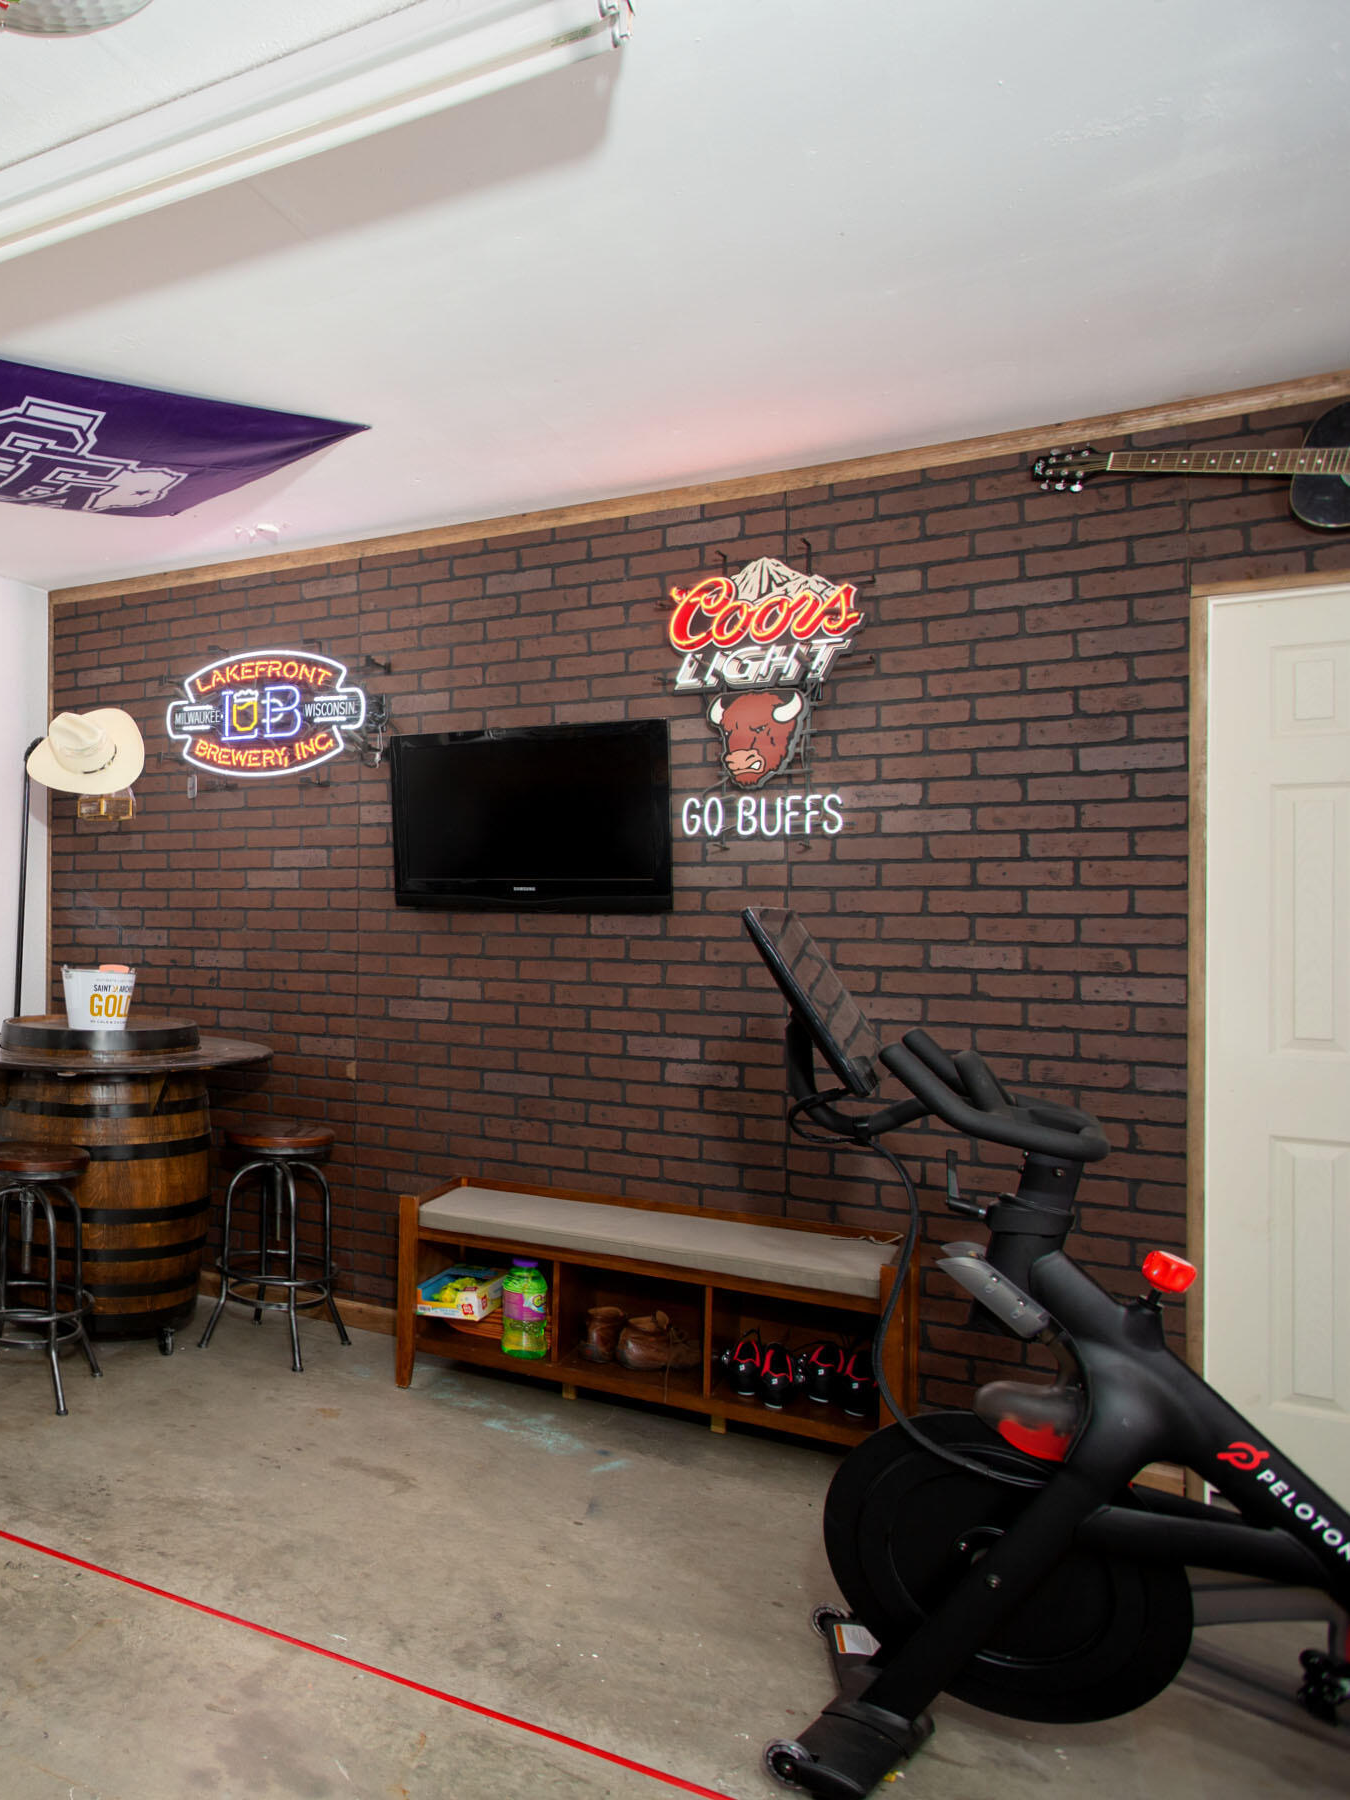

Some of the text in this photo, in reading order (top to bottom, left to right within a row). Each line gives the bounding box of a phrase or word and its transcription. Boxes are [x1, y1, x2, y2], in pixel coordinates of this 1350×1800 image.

[668, 576, 863, 652] Coors
[196, 659, 333, 694] LAKEFRONT
[674, 637, 852, 692] LIGHT
[174, 710, 222, 725] MILWAUKEE
[304, 700, 356, 718] WISCONSIN
[194, 738, 290, 768] BREWERY,
[681, 794, 844, 837] GO BUFFS
[93, 984, 112, 993] SAINT
